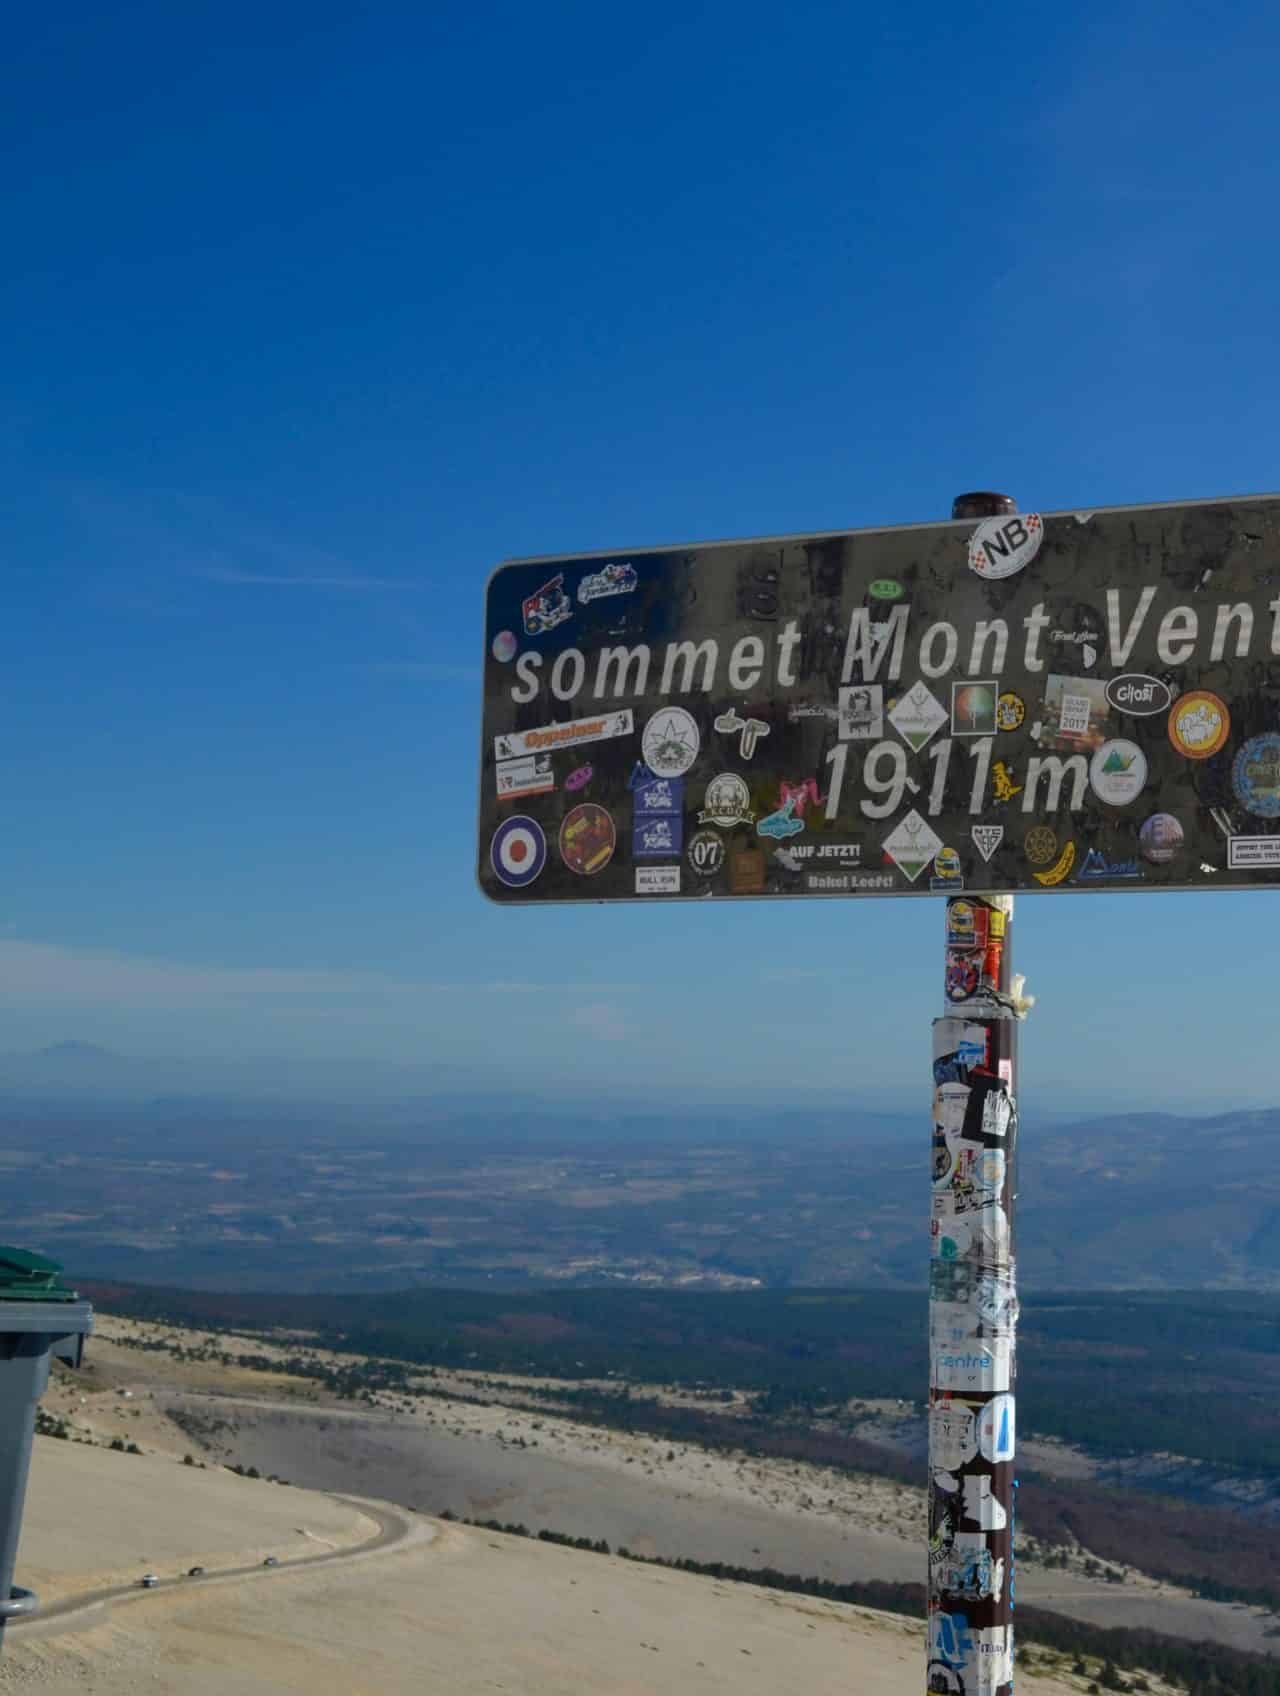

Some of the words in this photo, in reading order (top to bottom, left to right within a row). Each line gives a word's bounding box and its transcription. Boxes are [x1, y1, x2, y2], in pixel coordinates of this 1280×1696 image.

[982, 519, 1029, 566] NB
[511, 621, 802, 703] sommet
[839, 602, 1050, 684] Mont
[1062, 717, 1086, 730] 2017
[822, 737, 995, 821] 1911
[1021, 753, 1090, 813] m
[693, 841, 718, 865] 07
[790, 845, 815, 858] AUF
[817, 845, 861, 858] JETZT!
